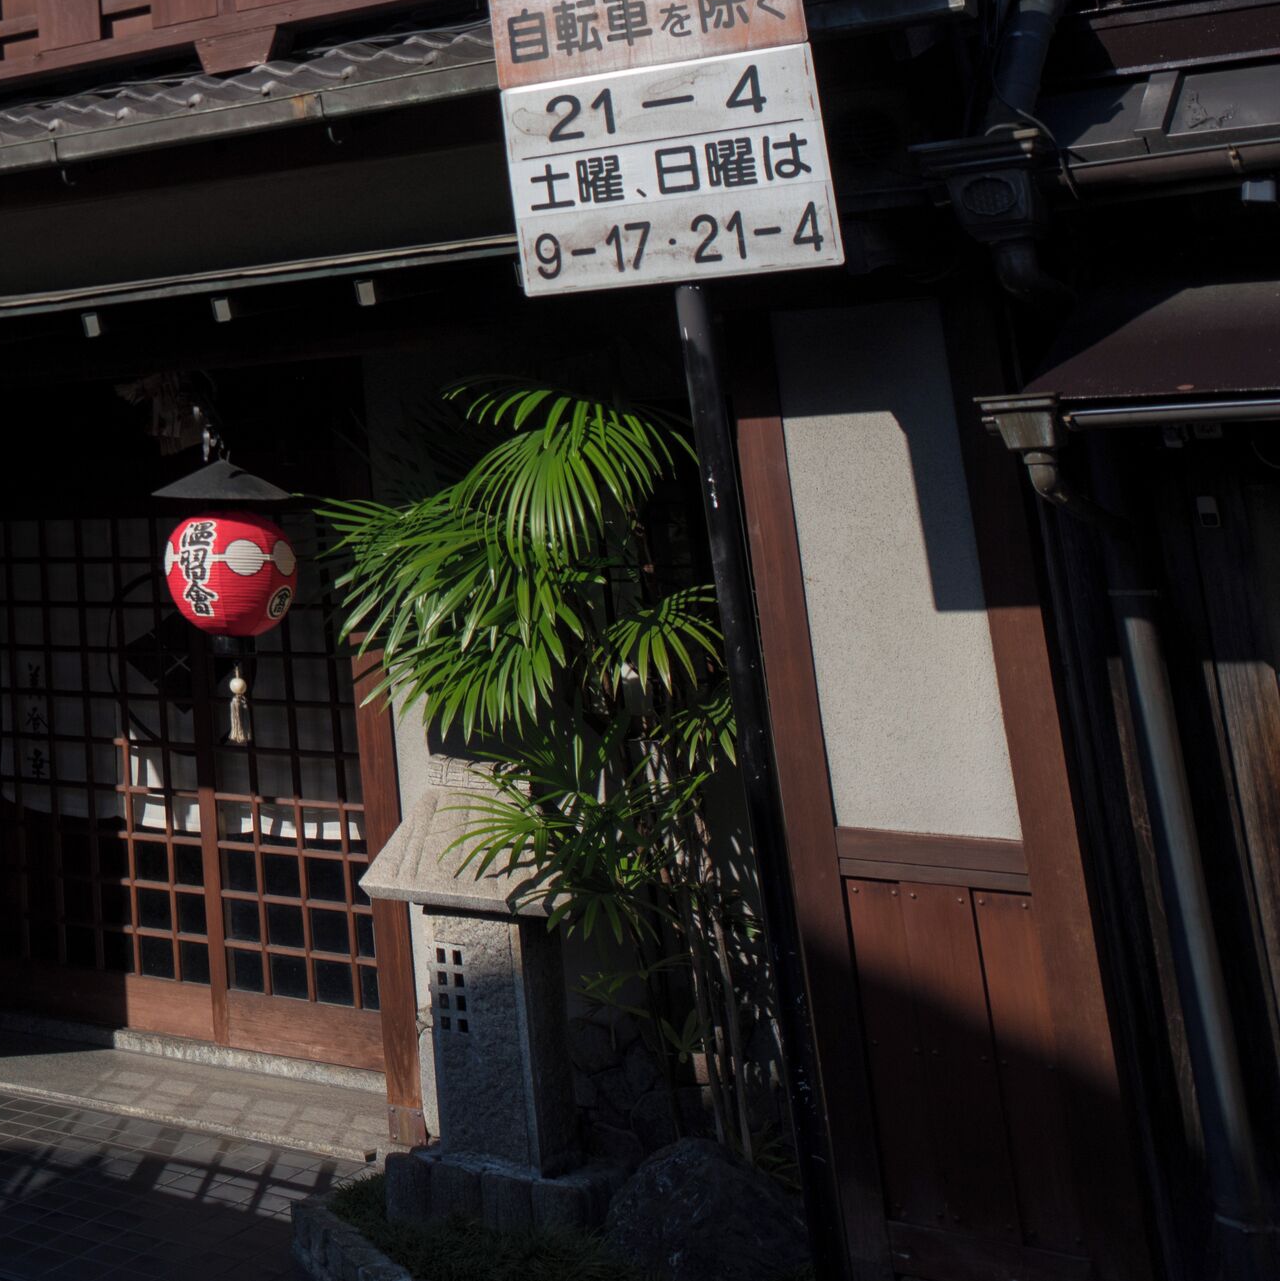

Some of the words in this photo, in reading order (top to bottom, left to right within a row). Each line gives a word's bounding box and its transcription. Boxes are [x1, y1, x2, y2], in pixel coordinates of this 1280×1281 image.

[529, 131, 814, 212] 土曜、日曜は
